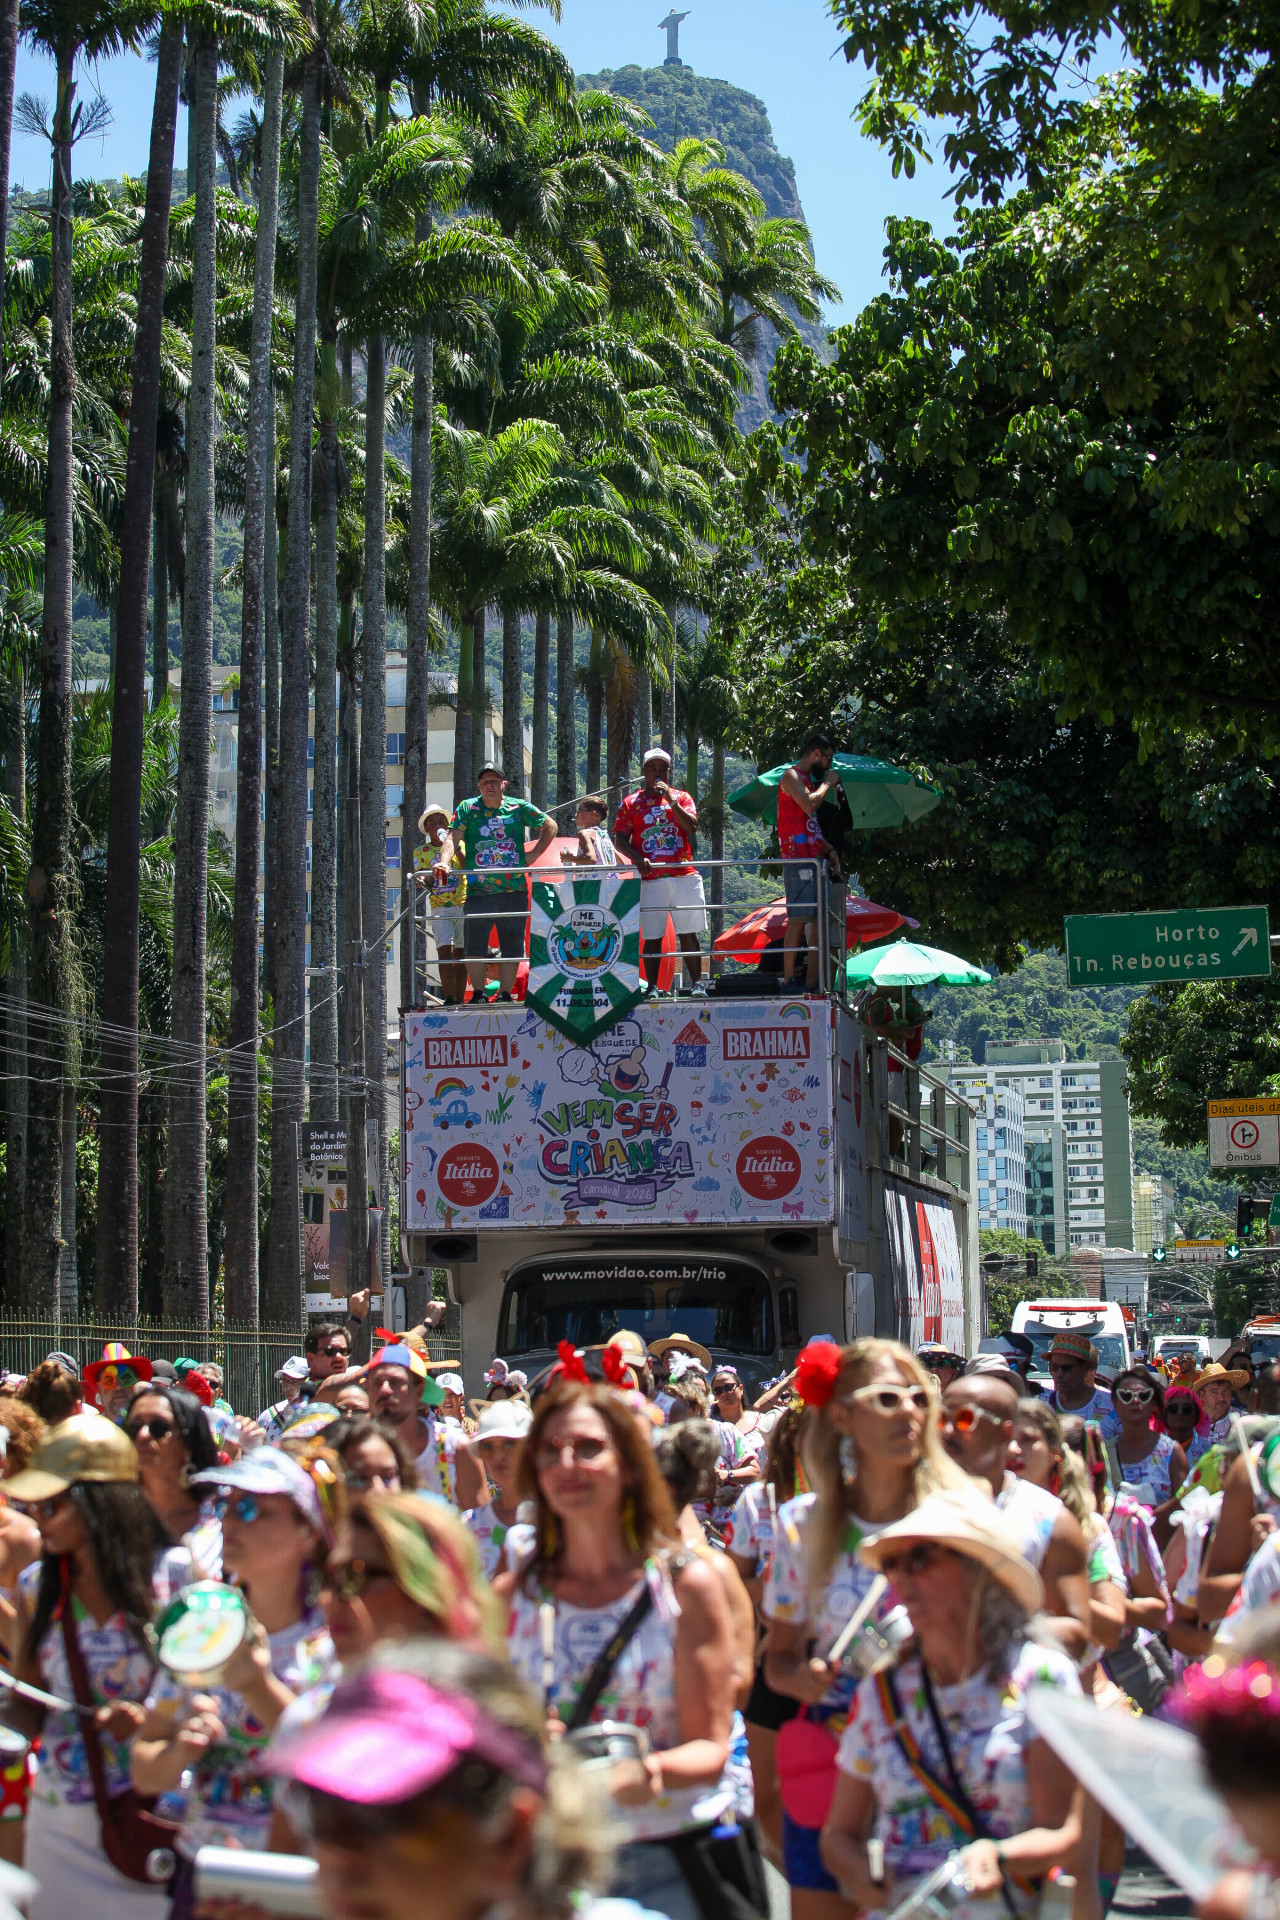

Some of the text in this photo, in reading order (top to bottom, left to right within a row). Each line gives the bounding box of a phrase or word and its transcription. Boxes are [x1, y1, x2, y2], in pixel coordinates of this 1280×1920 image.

[580, 911, 595, 920] ME
[1156, 925, 1220, 943] Horto
[1073, 952, 1221, 972] Tn. Rebouças
[556, 998, 609, 1008] 11.09.2004
[727, 1030, 807, 1057] BRAHMA
[428, 1039, 505, 1066] BRAHMA
[1211, 1104, 1235, 1114] Dias
[1238, 1102, 1265, 1113] úteis
[541, 1099, 678, 1141] VEM SER
[310, 1130, 329, 1140] Shell
[310, 1141, 321, 1150] do
[310, 1152, 344, 1161] Botânico
[1226, 1151, 1262, 1162] Ônibus
[443, 1162, 494, 1179] Itália
[742, 1156, 796, 1173] Itália
[583, 1184, 652, 1199] carnaval 2026
[542, 1266, 727, 1282] www.movidao.com.br/trio
